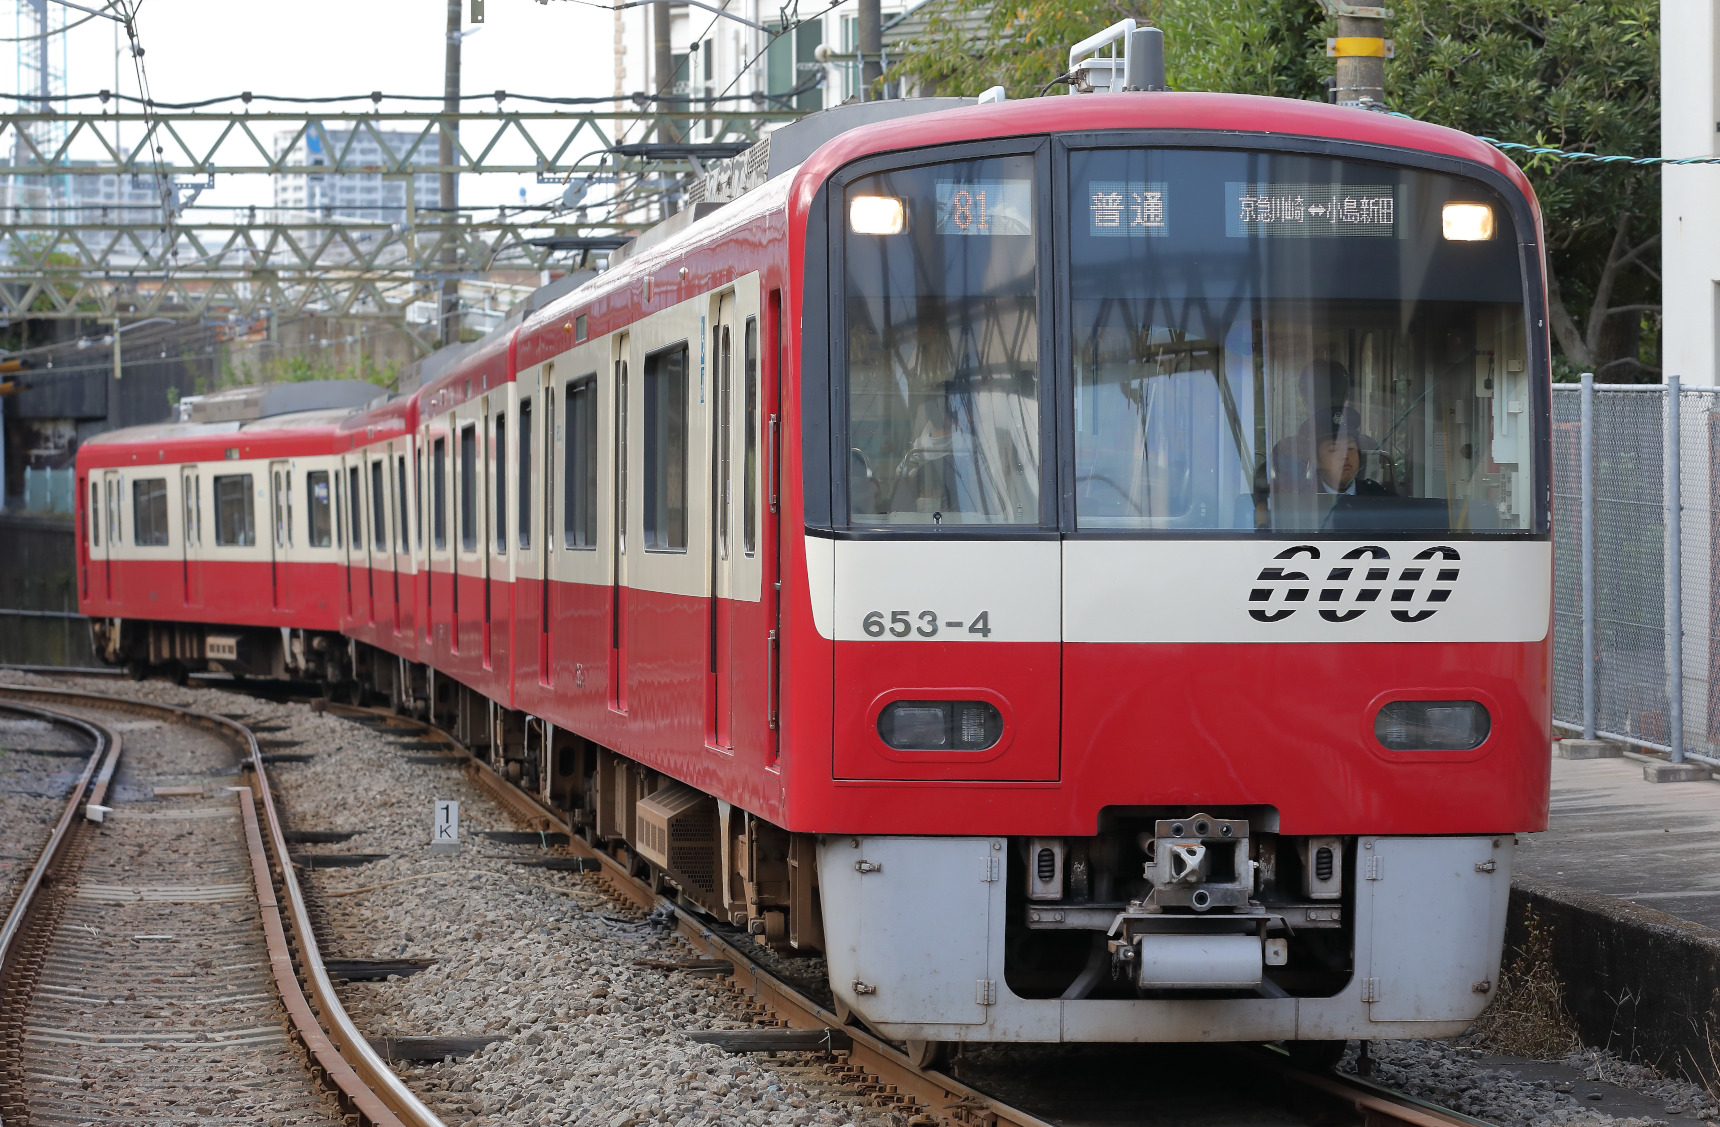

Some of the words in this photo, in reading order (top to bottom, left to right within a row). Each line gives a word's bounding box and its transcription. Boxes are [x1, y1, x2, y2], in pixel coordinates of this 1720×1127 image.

[954, 190, 989, 229] 81
[1090, 192, 1165, 228] 普通
[1238, 194, 1305, 223] 京急川崎
[1326, 195, 1394, 224] 小島新田
[1248, 545, 1461, 623] 600
[862, 610, 992, 638] 653-4
[440, 803, 450, 824] 1
